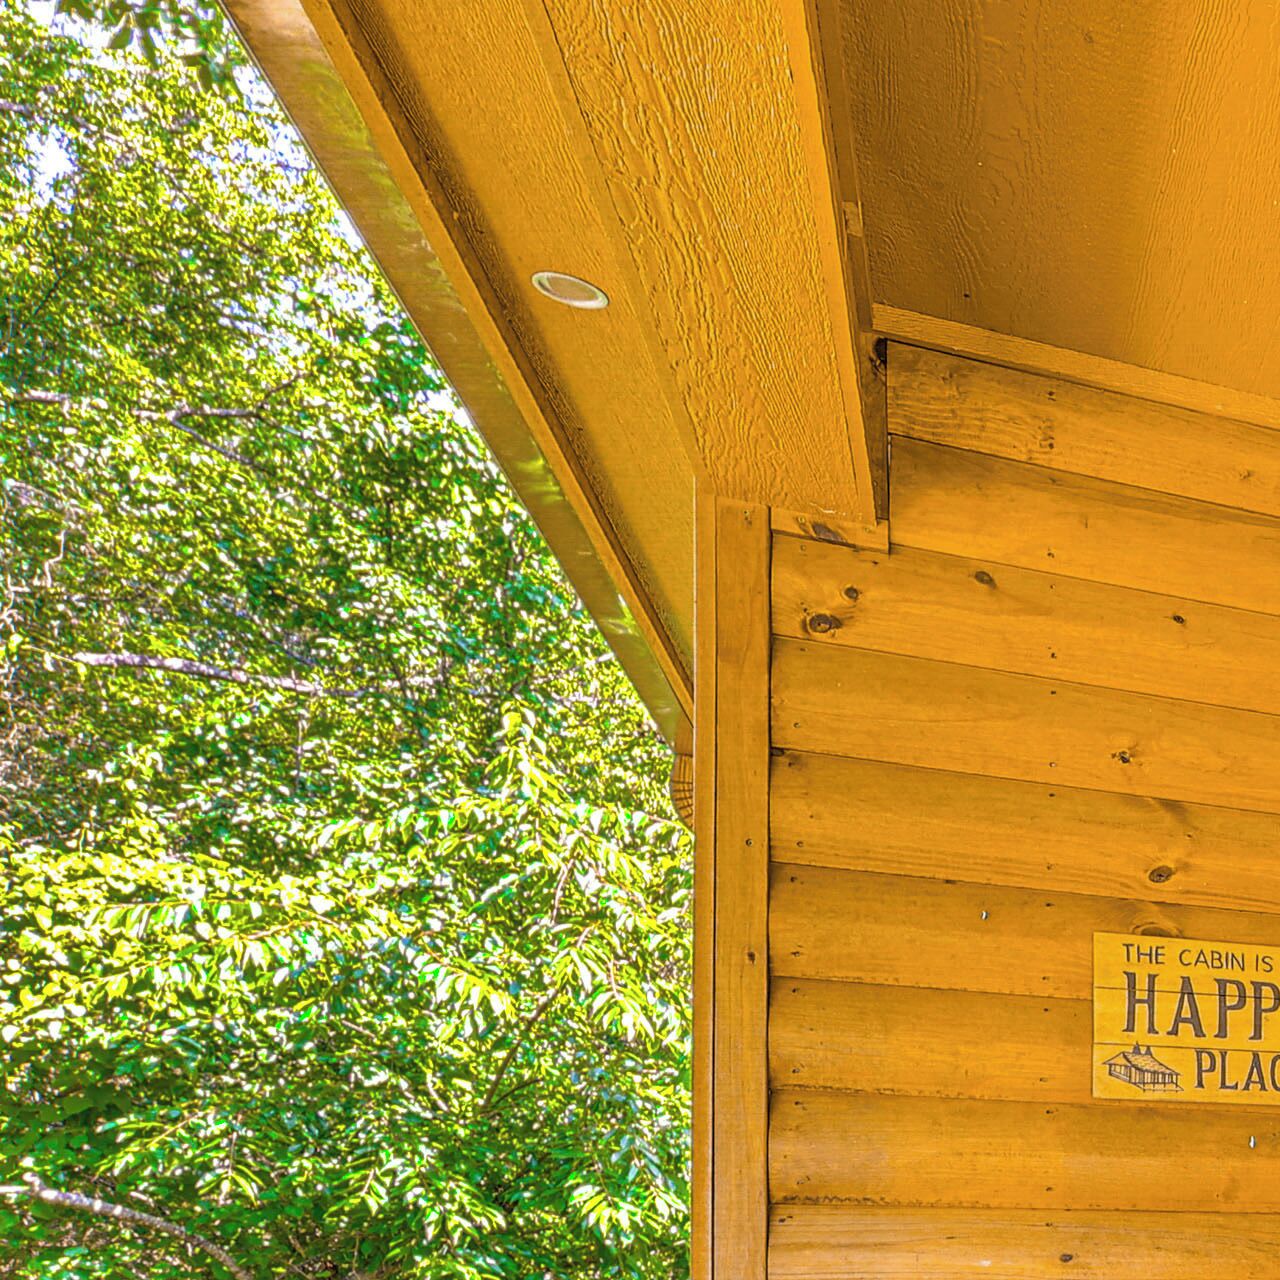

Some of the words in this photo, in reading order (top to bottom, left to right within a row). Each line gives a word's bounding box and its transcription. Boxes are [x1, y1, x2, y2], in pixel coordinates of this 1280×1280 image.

[1122, 942, 1165, 965] THE
[1178, 948, 1245, 972] CABIN
[1255, 953, 1273, 973] IS
